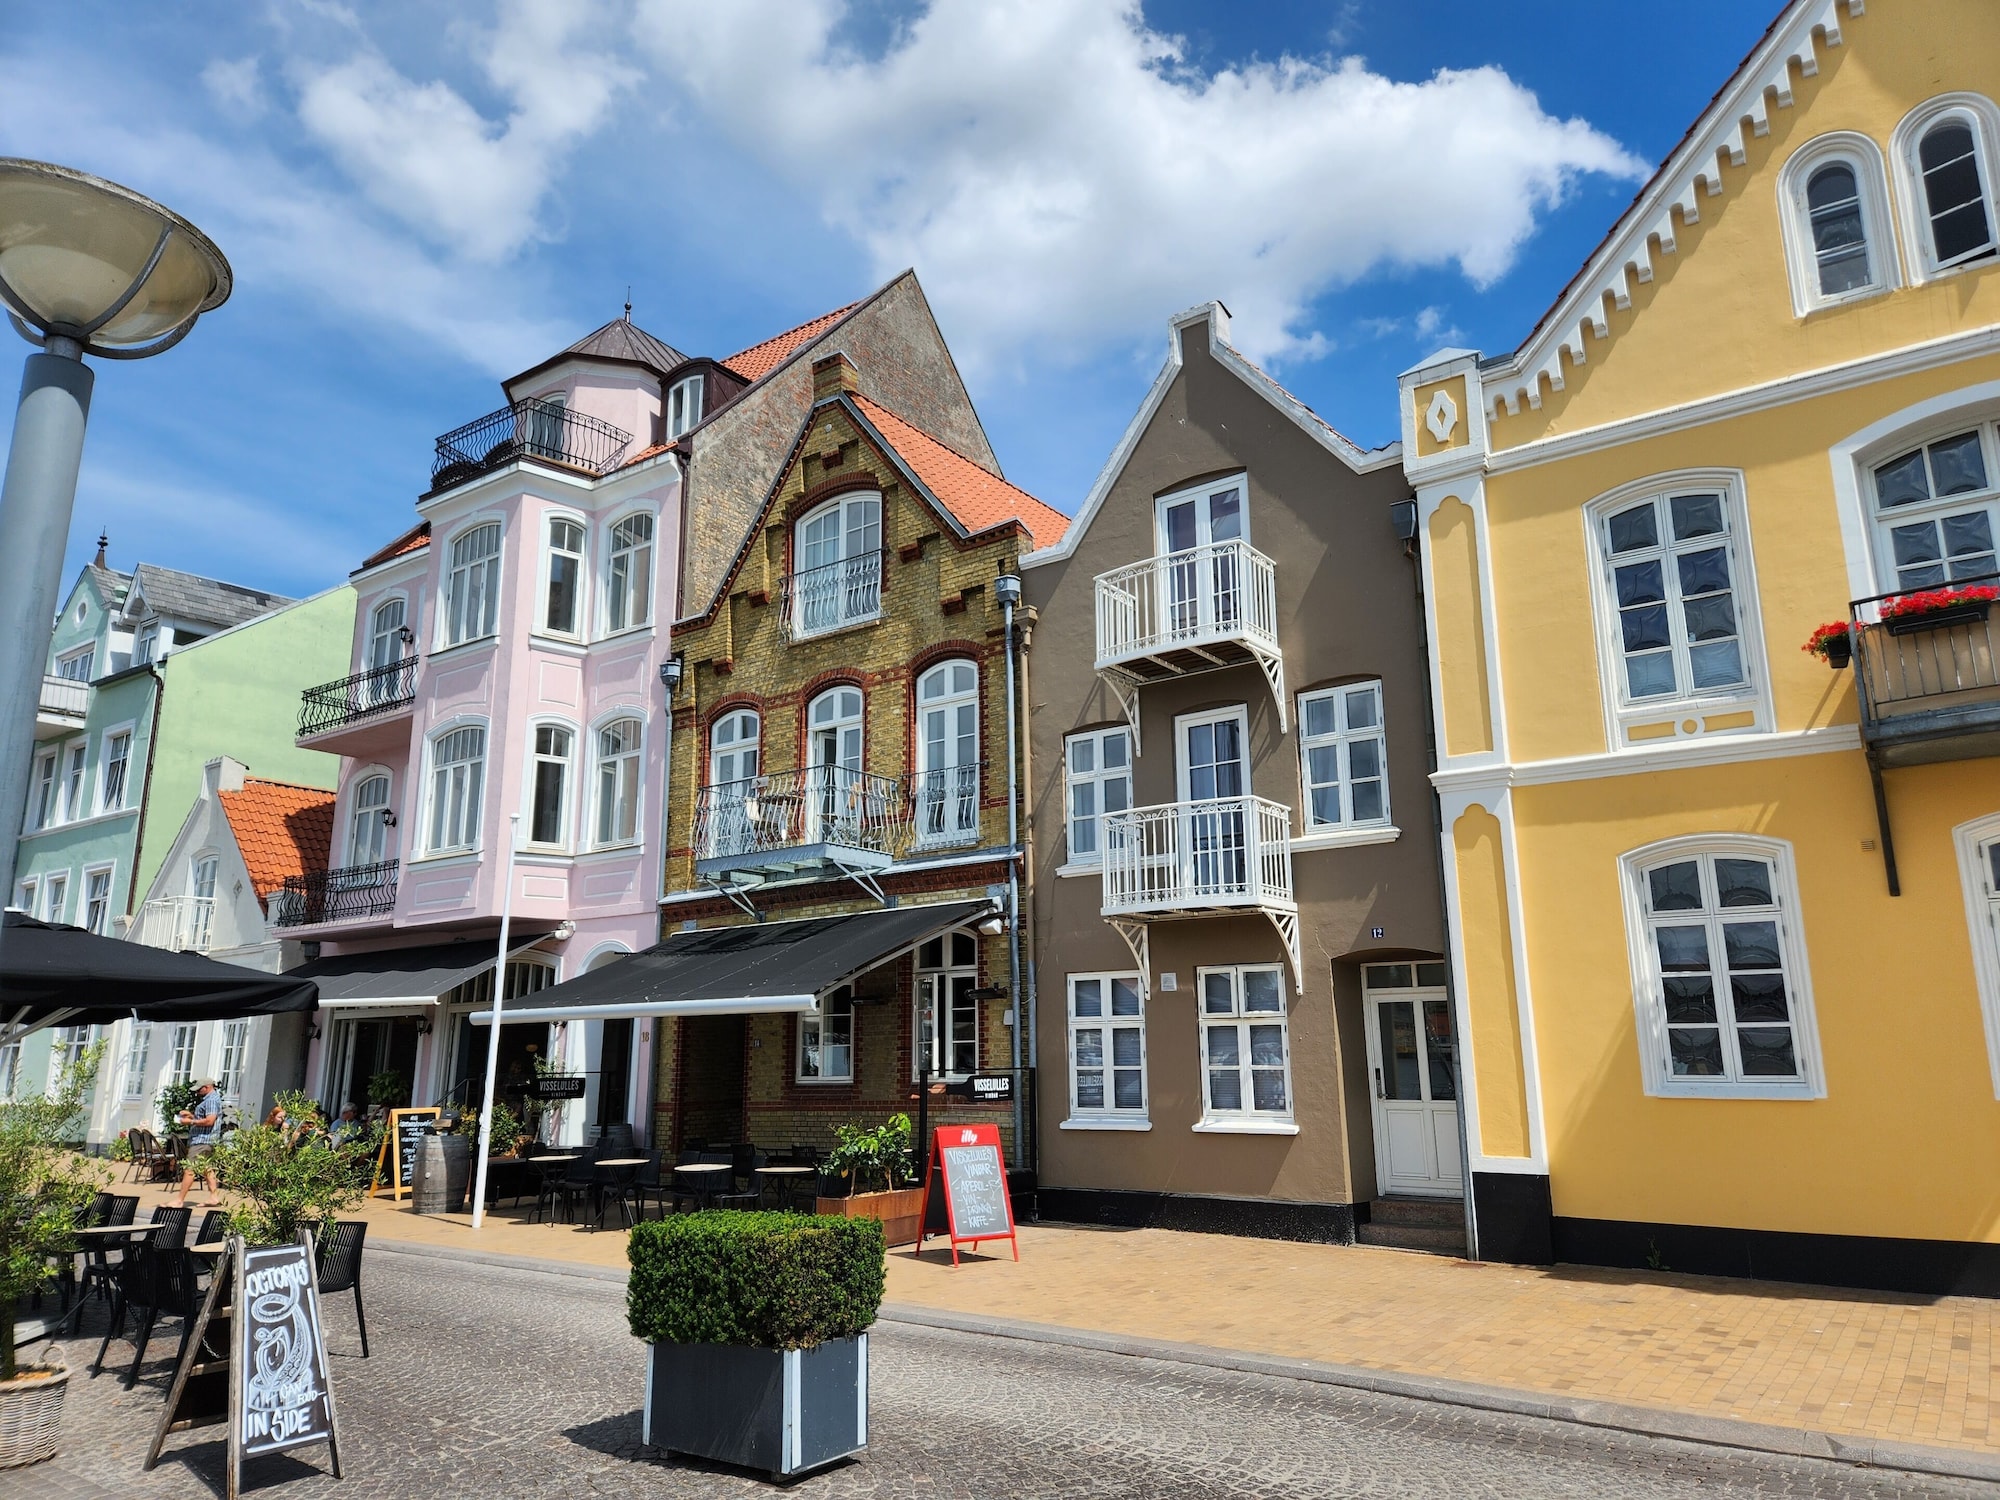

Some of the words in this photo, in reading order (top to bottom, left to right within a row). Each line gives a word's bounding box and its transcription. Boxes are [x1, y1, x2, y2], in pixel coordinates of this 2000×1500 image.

[1373, 928, 1382, 938] 12
[641, 1031, 650, 1042] 18
[540, 1080, 580, 1091] VISSELULLES
[974, 1078, 1009, 1091] VISSELULLES
[961, 1130, 977, 1145] illy
[246, 1259, 309, 1297] OCTOPUS
[248, 1411, 270, 1438] IN
[270, 1407, 312, 1441] SIDE
